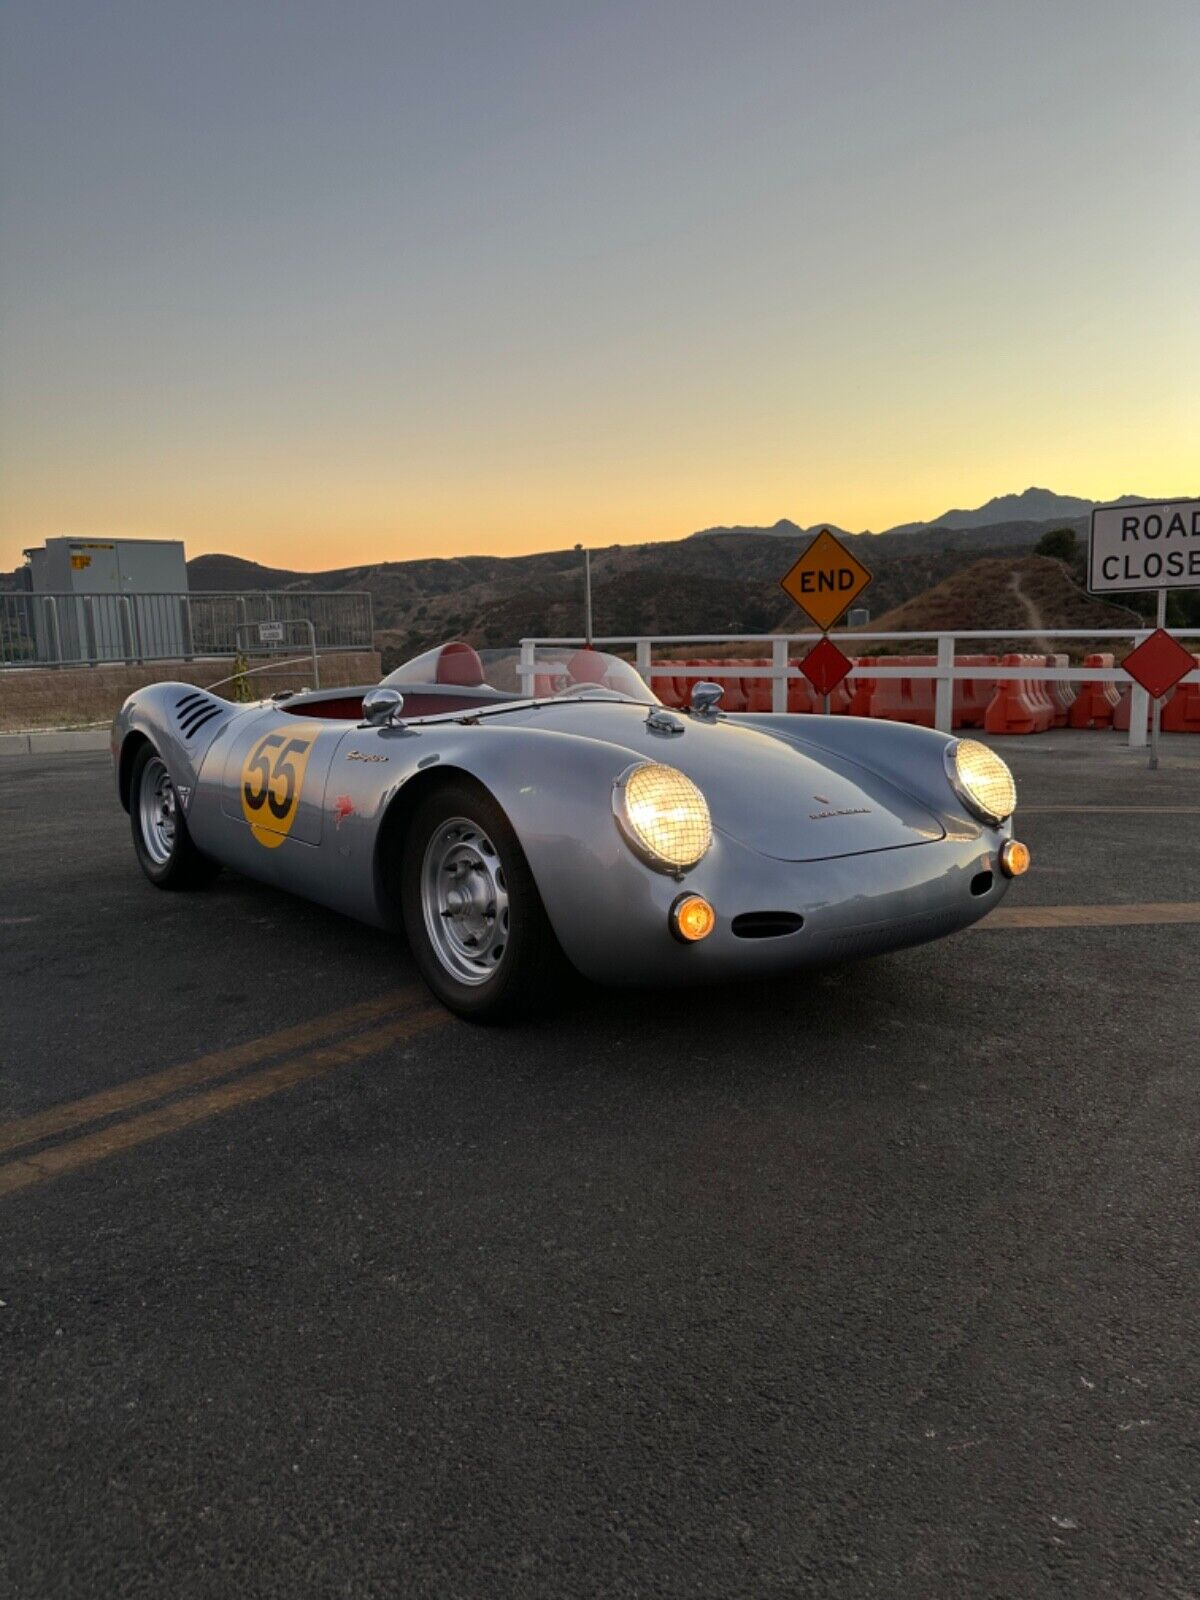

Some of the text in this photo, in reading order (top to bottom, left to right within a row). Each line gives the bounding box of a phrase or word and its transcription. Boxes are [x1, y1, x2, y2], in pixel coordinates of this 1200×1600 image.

[801, 568, 855, 592] END
[1102, 551, 1200, 580] CLOSE
[244, 734, 311, 819] 55
